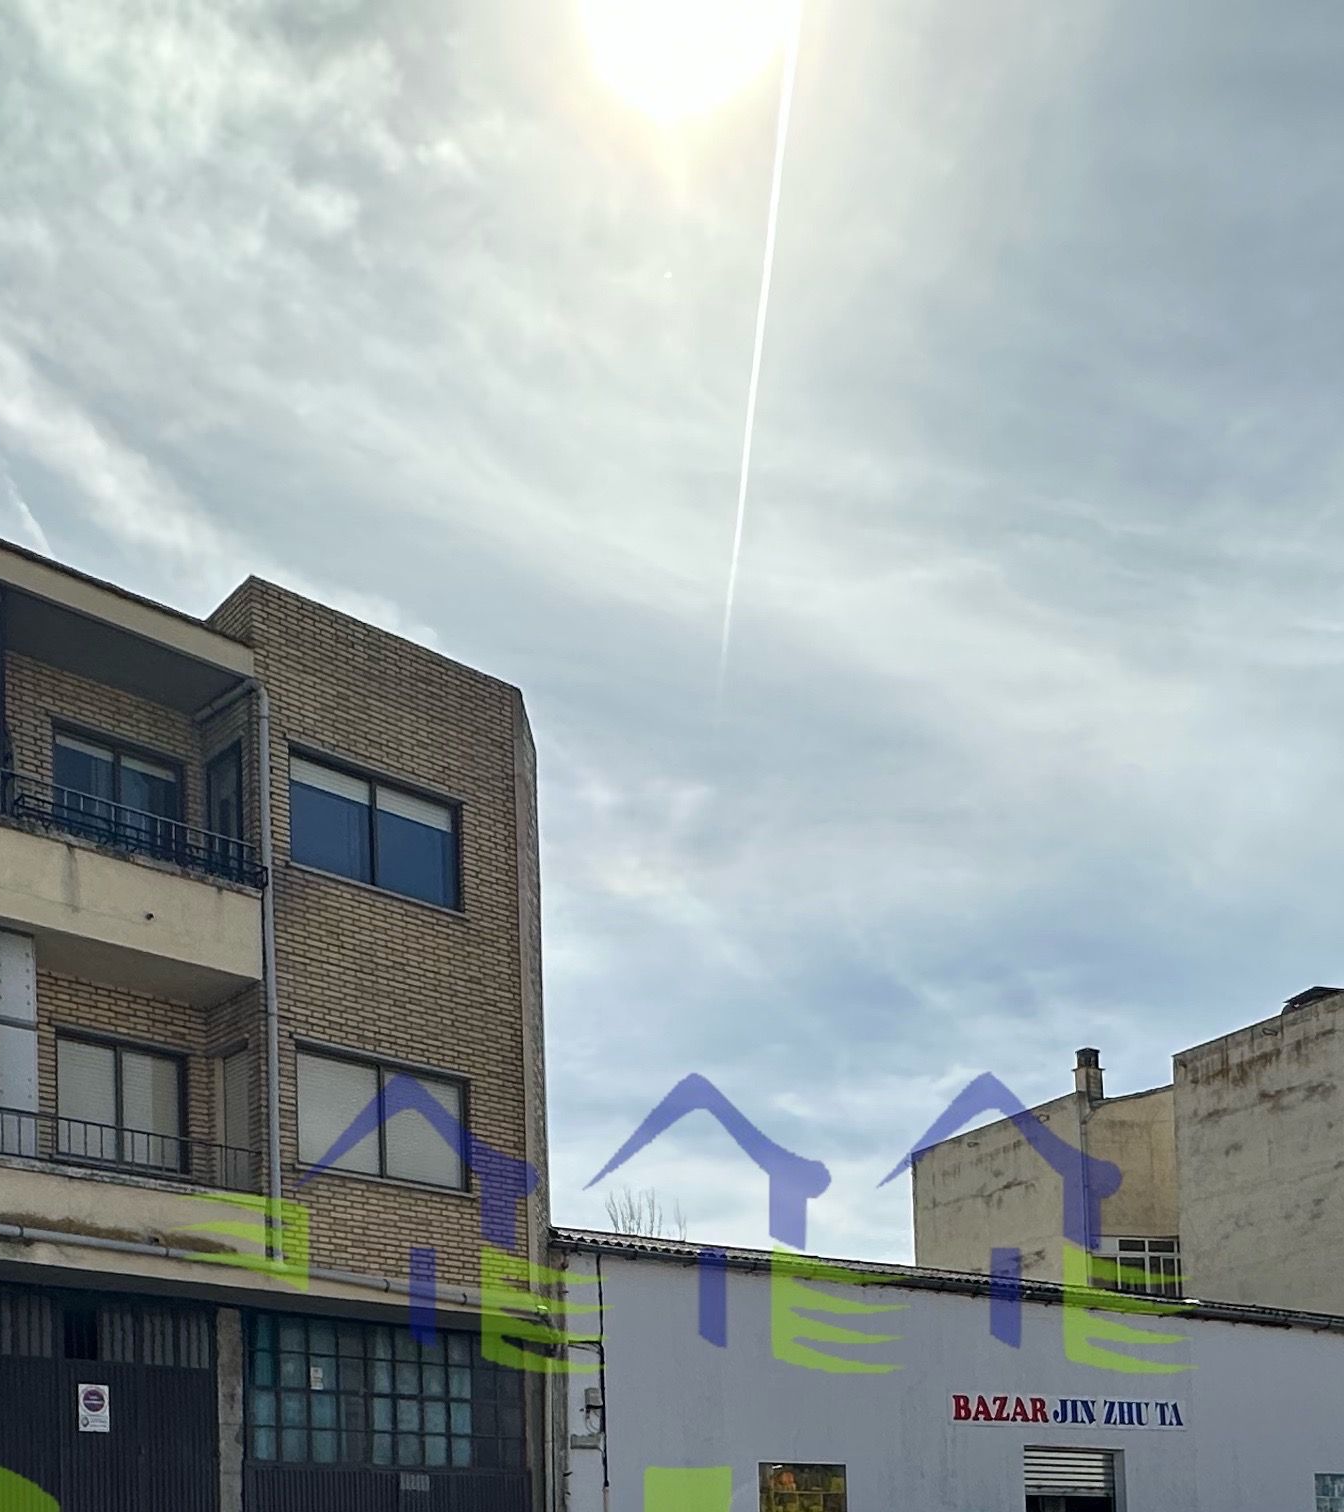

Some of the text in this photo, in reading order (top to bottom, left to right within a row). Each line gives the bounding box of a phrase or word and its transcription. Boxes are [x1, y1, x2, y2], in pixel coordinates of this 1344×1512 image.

[953, 1394, 1184, 1426] BAZAR JIN ZHU TA
